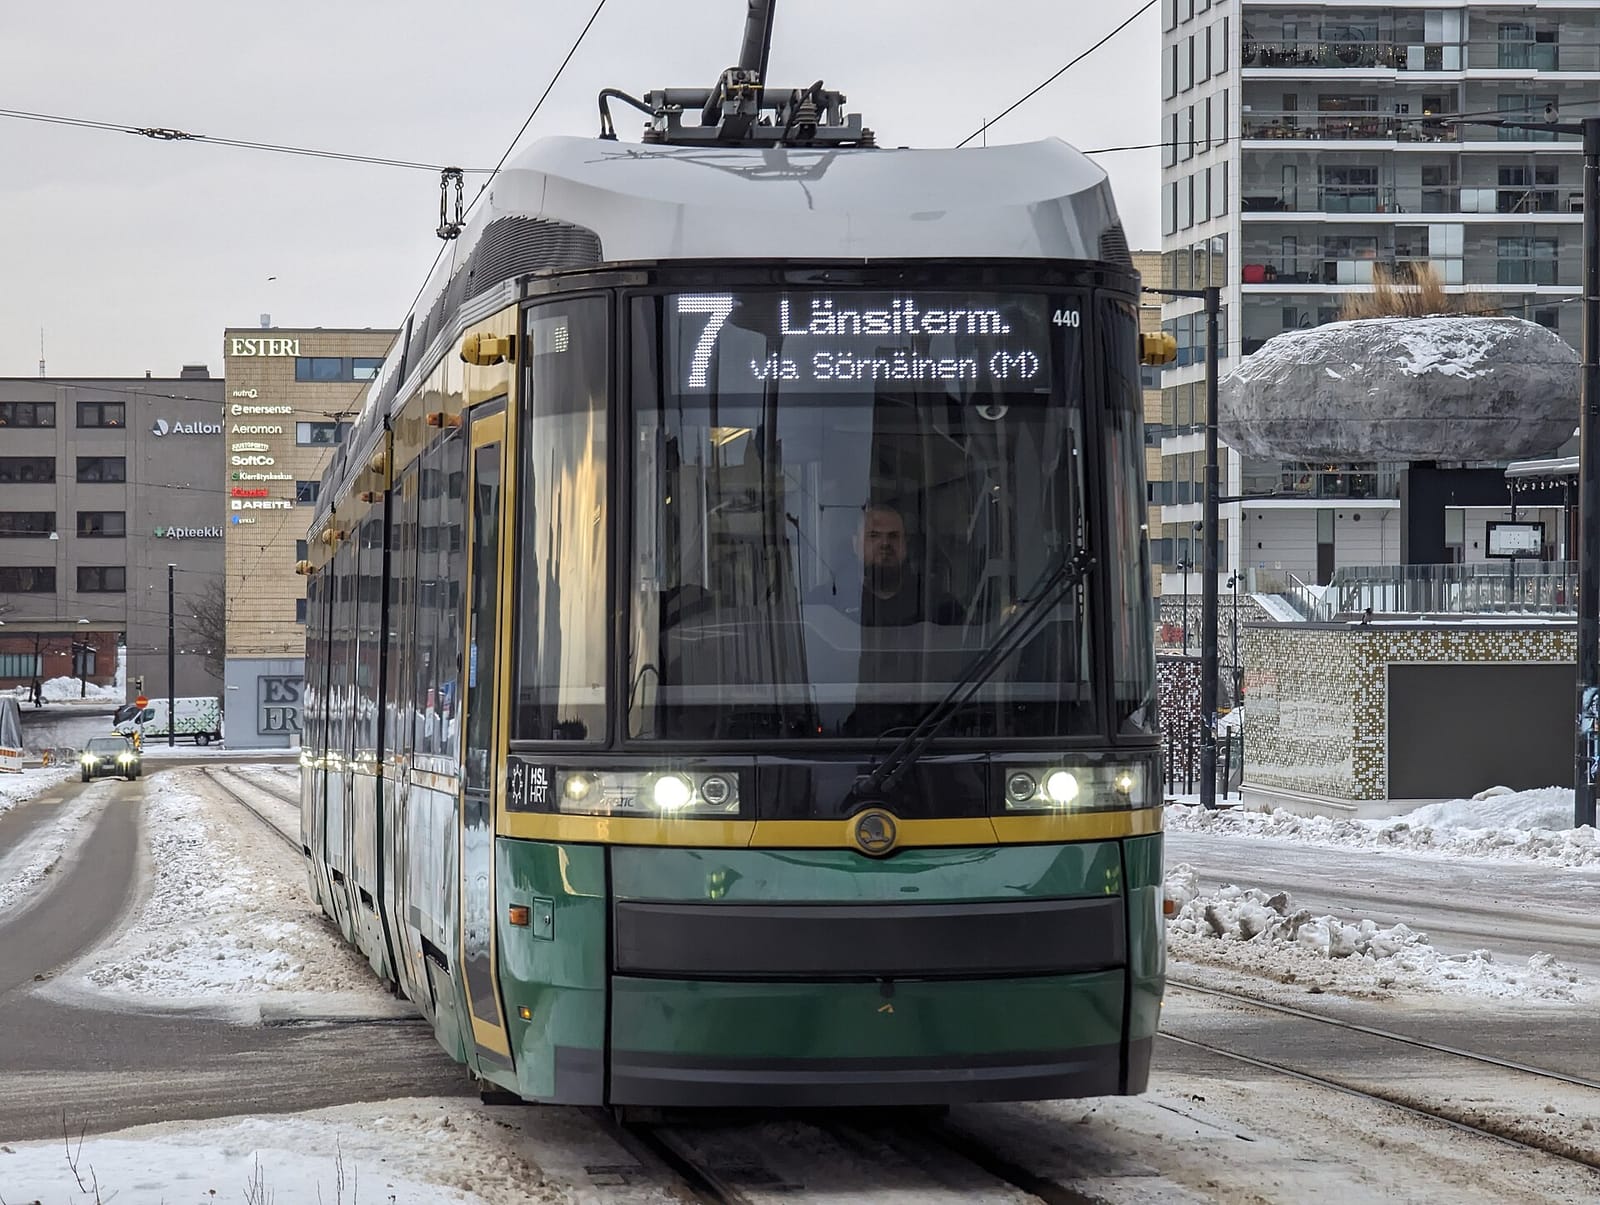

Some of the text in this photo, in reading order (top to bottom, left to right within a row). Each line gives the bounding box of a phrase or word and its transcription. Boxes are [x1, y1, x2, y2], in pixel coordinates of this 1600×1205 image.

[1052, 309, 1080, 328] 440
[677, 296, 1011, 388] 7 Länsiterm.
[750, 351, 1039, 380] via Sörnäinen (M)
[172, 421, 221, 434] Aallon
[231, 424, 283, 434] Aeromon
[231, 455, 275, 466] SoftCo
[166, 526, 223, 540] Apteekki
[263, 678, 304, 703] ES
[530, 767, 549, 785] HSL
[529, 786, 549, 803] HRT
